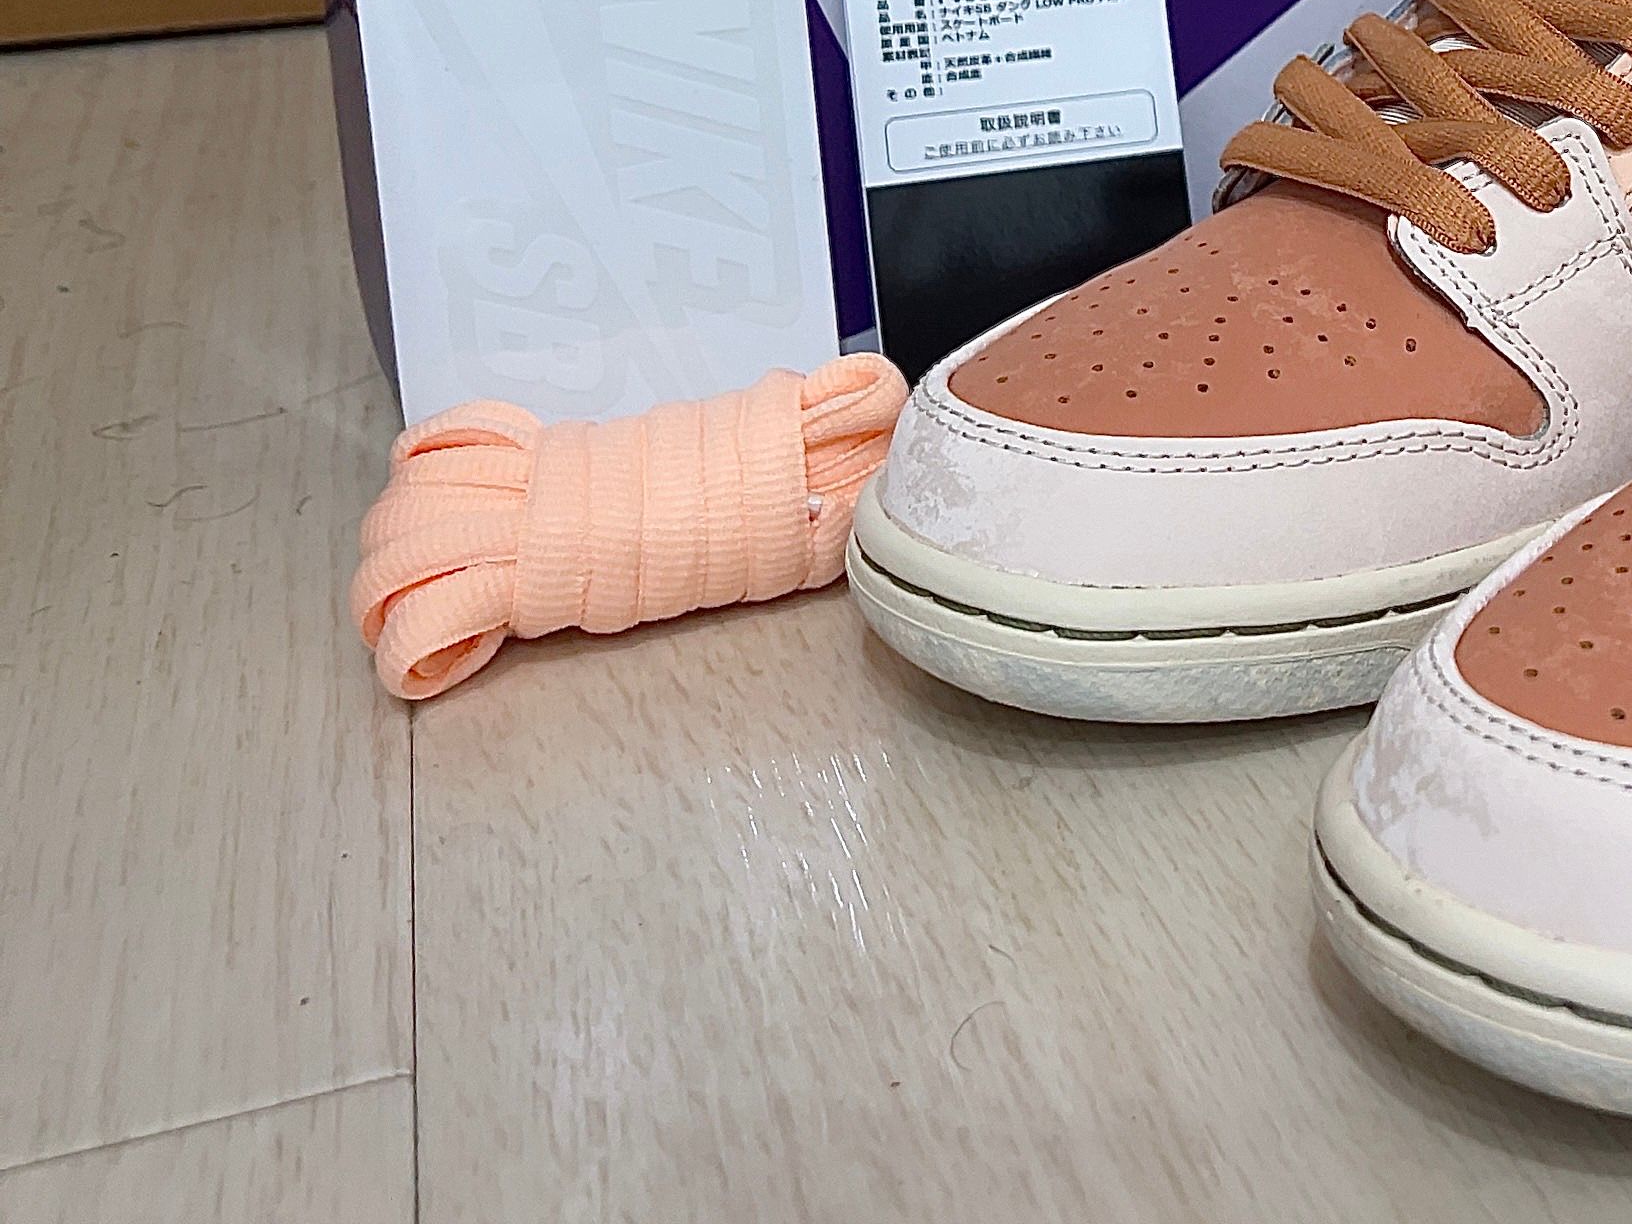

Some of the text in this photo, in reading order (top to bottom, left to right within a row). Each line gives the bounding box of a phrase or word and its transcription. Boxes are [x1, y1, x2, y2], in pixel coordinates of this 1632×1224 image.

[979, 108, 1062, 132] 取扱説明書
